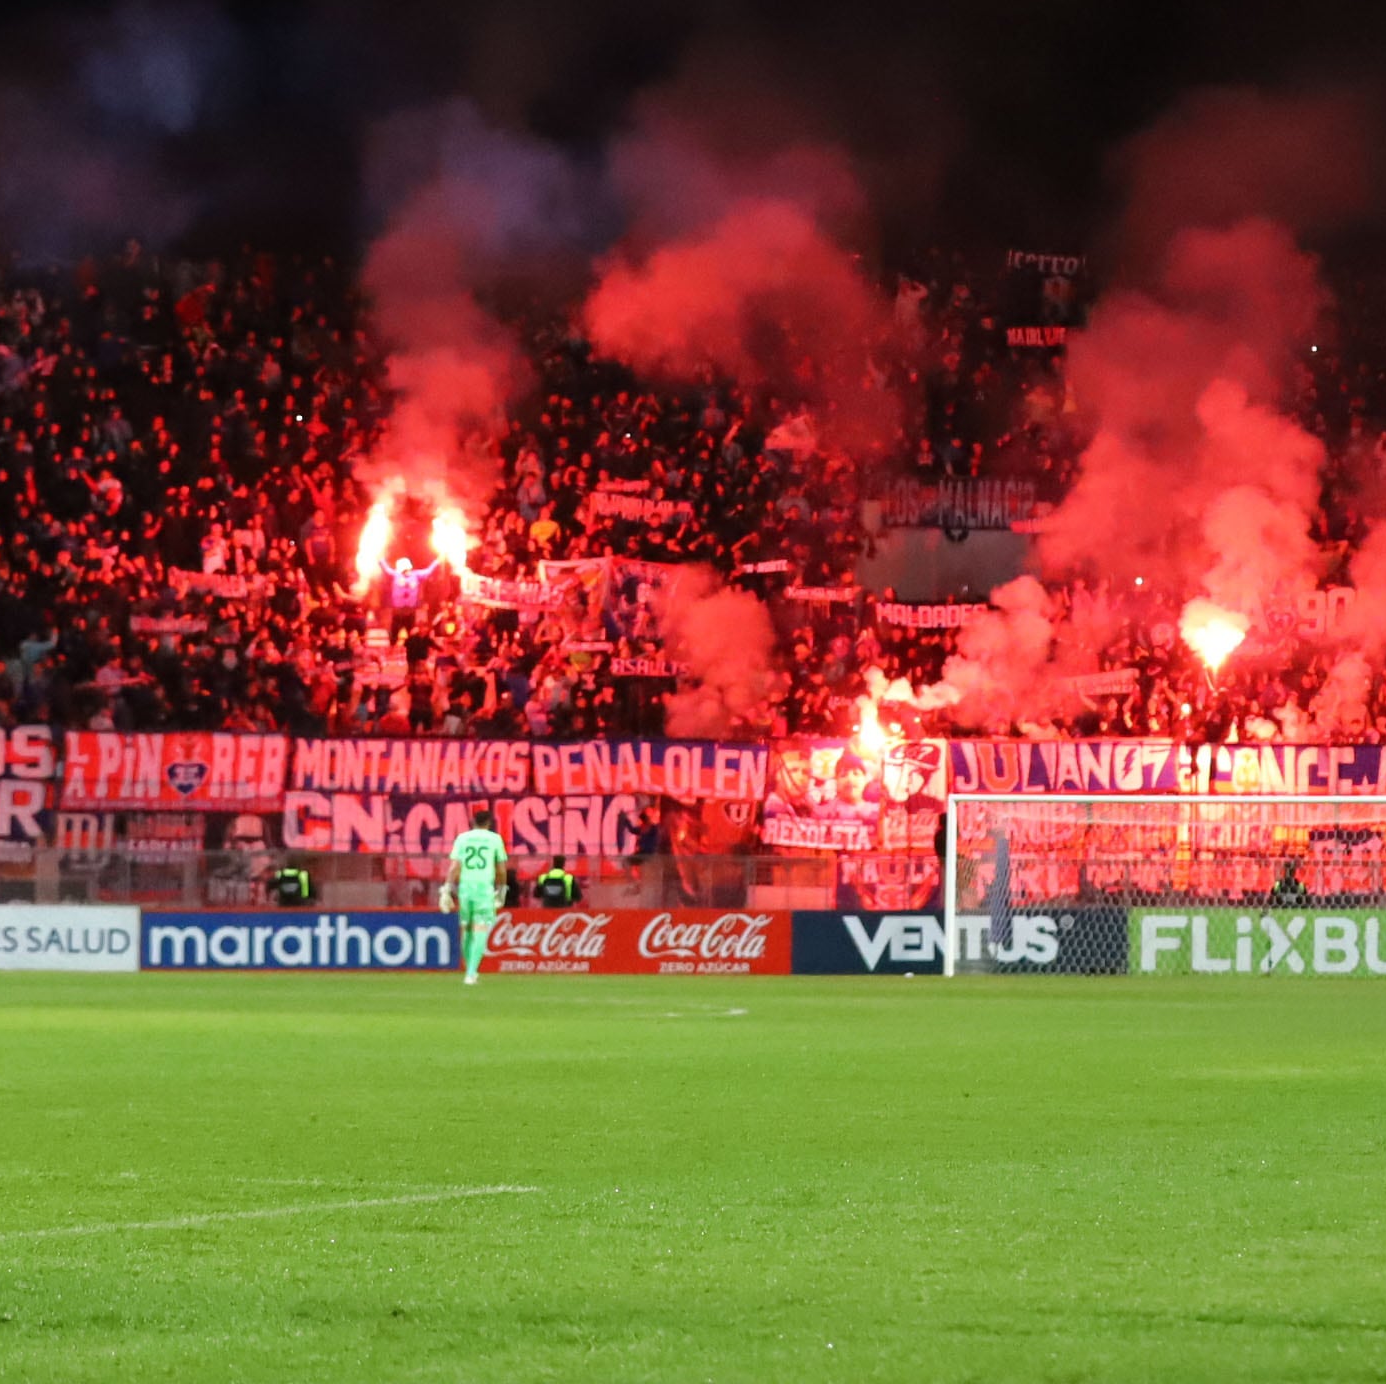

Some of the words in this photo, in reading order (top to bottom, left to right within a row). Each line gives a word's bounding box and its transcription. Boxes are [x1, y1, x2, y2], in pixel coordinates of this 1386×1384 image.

[293, 738, 531, 794] MONTANIAKOS
[464, 845, 489, 870] 25
[27, 927, 131, 955] SALUD
[149, 915, 452, 966] marathon
[638, 912, 773, 958] Coca-Cola
[500, 960, 534, 972] ZERO
[660, 961, 694, 973] ZERO
